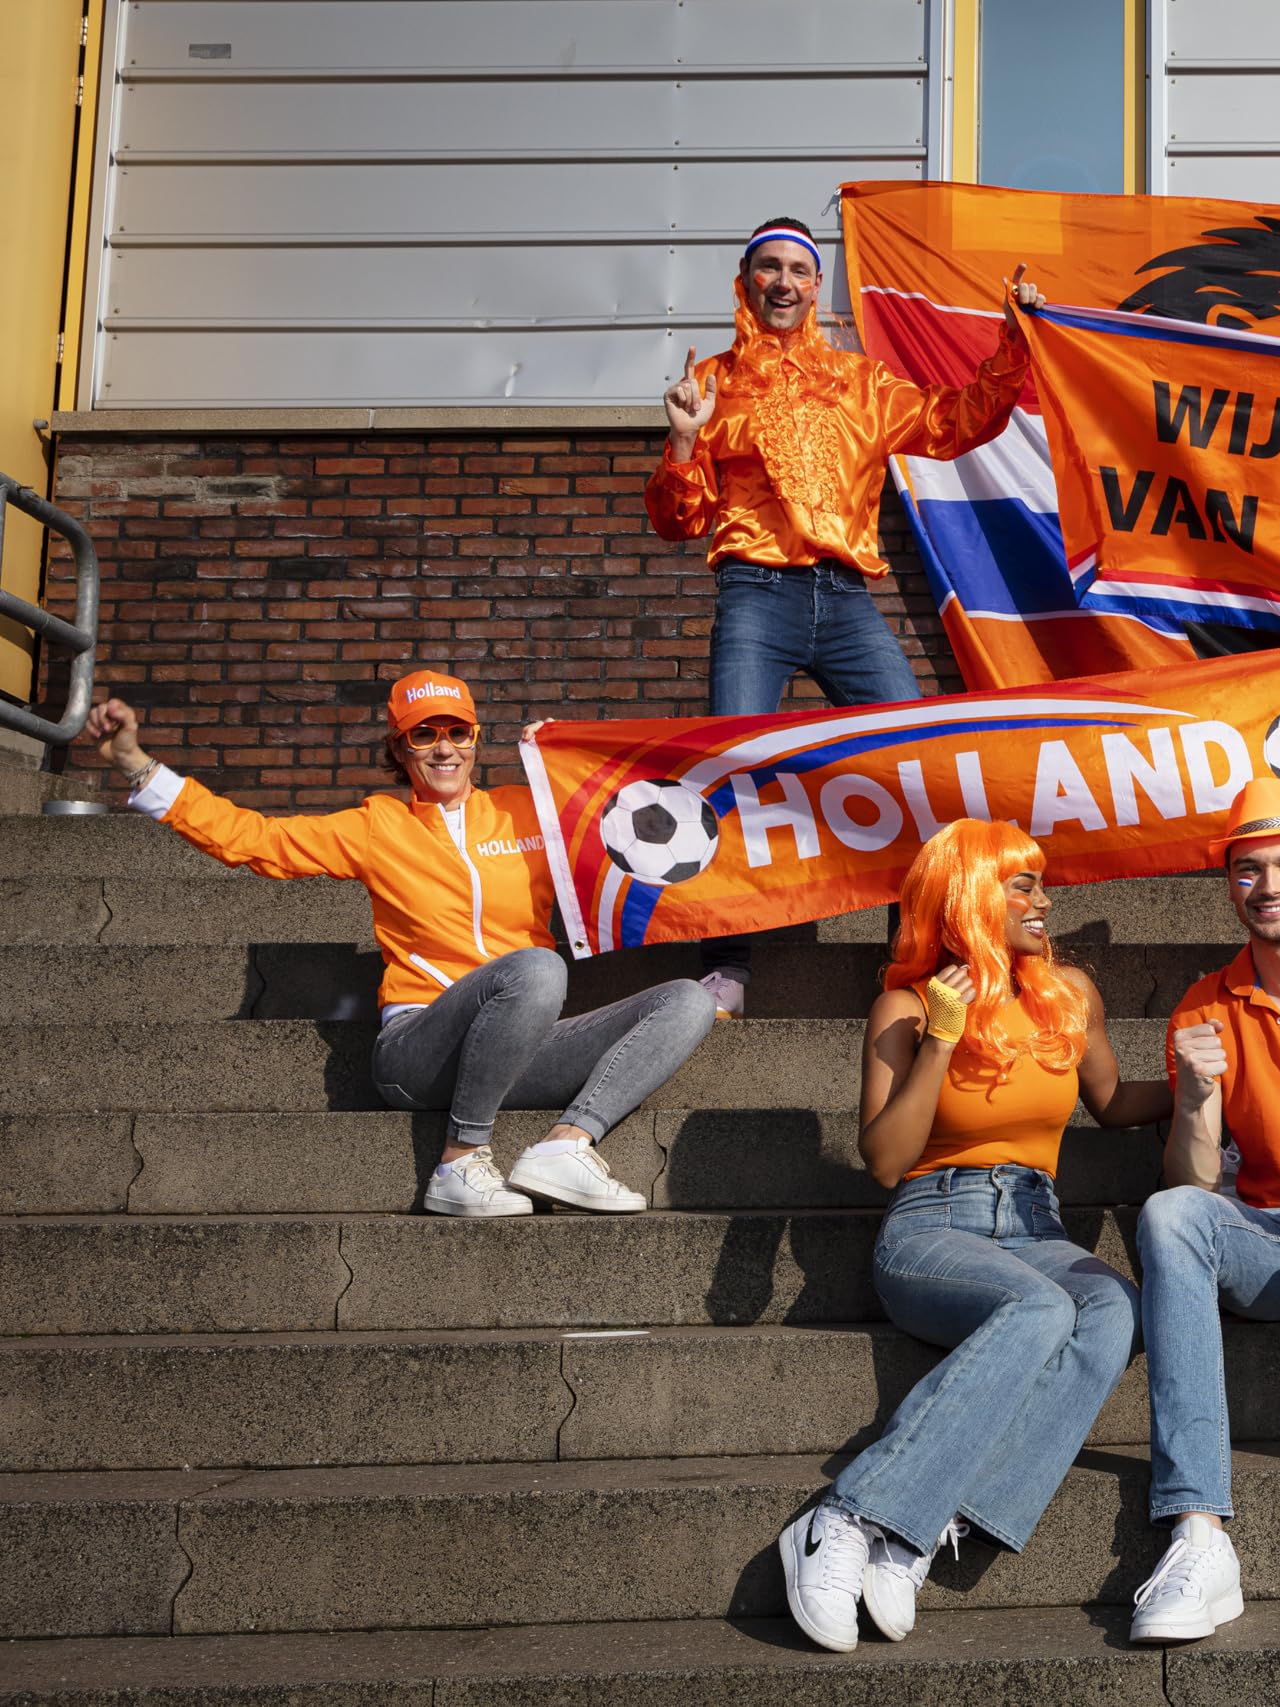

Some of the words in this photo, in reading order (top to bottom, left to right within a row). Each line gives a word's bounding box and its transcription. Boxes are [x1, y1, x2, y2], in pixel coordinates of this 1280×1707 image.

[1099, 466, 1258, 554] VAN
[406, 683, 460, 703] Holland
[730, 721, 1254, 868] HOLLAND
[477, 835, 545, 856] HOLLAND
